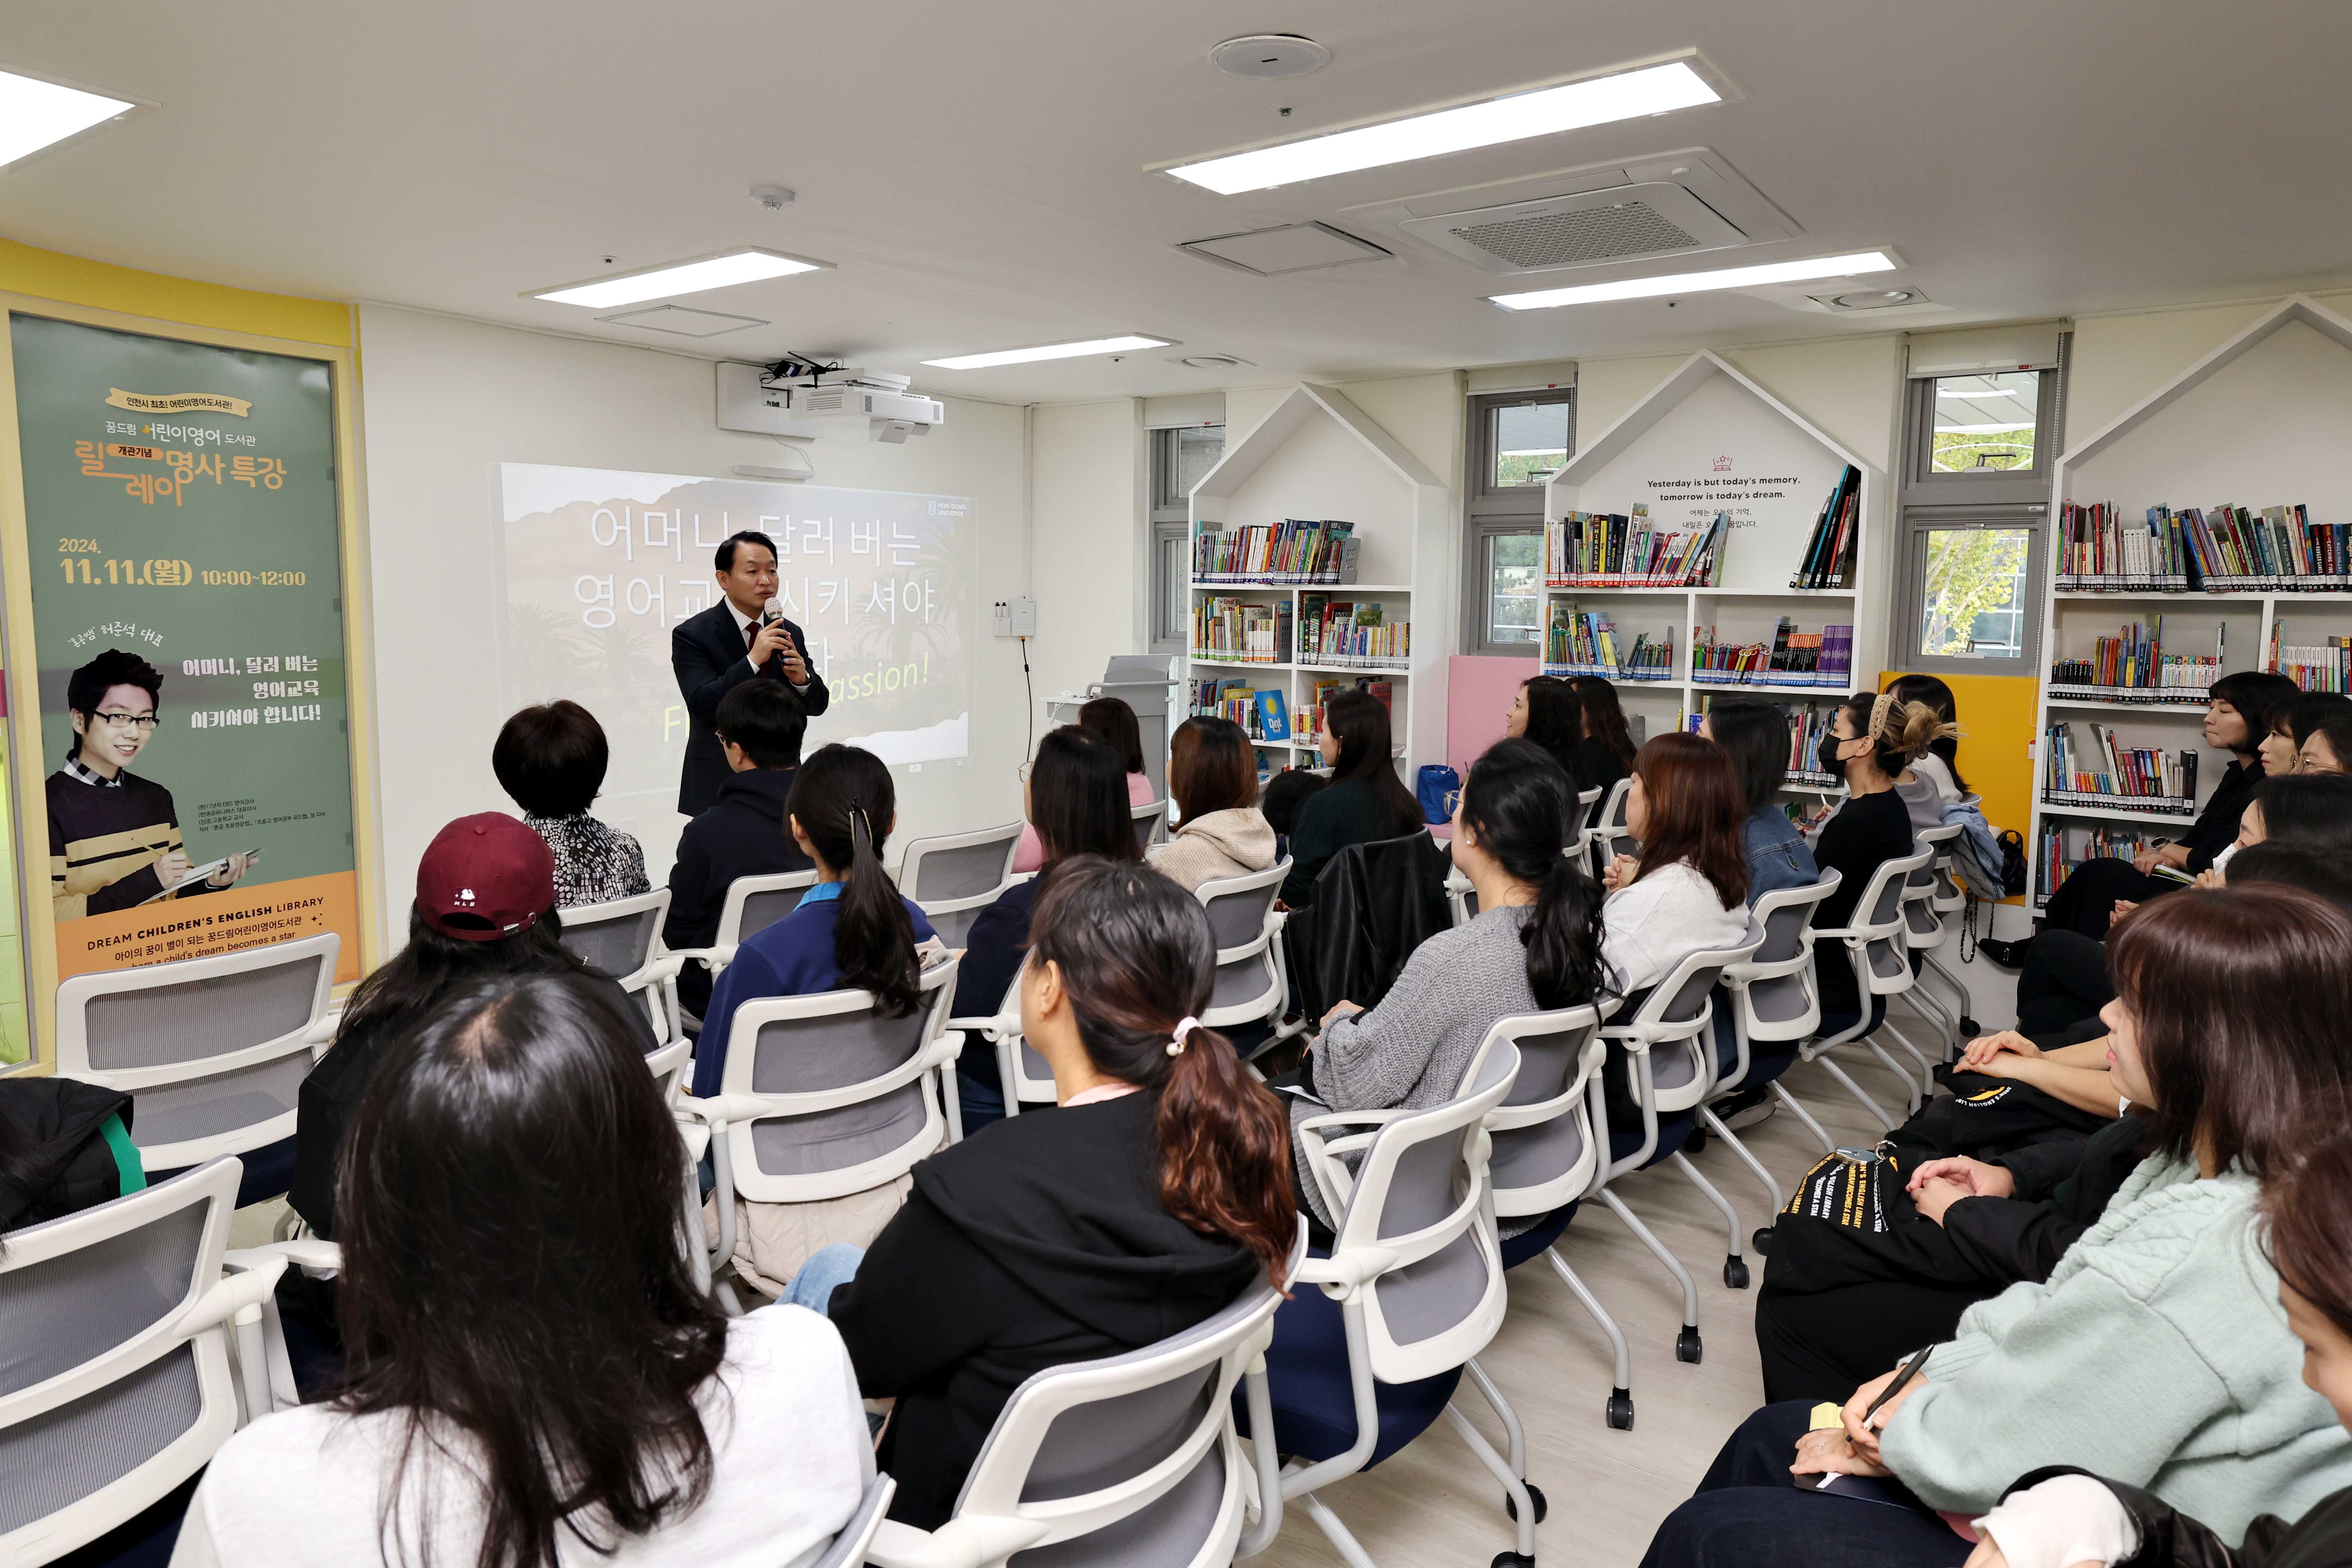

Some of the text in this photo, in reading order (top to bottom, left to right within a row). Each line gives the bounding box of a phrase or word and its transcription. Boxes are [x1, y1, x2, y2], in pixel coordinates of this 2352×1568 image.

[127, 397, 232, 410] 인천시 최초! 어린이영어도서관!
[105, 421, 257, 447] 꿈드림 어린이영어 도서관
[118, 446, 152, 458] 개관기념
[166, 450, 226, 485] 명사
[230, 456, 287, 490] 특강
[1648, 479, 1691, 488] Yesterday
[1723, 477, 1756, 486] today's
[1759, 477, 1800, 485] memory,
[1716, 491, 1750, 500] today's
[1736, 508, 1751, 516] 기억,
[591, 506, 921, 566] 어머니 달러 버는
[1682, 521, 1703, 529] 내일은
[1729, 520, 1759, 528] 꿈입니다.
[58, 538, 101, 554] 2024.
[60, 558, 306, 586] 11.11.(월) 10:00~12:00
[574, 574, 711, 628] 영어교
[100, 621, 135, 638] 허준석
[140, 628, 163, 647] 대표
[182, 655, 318, 676] 어머니, 달러 버는
[253, 680, 319, 699] 영어교육
[826, 651, 929, 705] assion!
[191, 704, 321, 729] 시키셔야 합니다!
[1268, 717, 1282, 729] Dot
[88, 897, 324, 950] DREAM CHILDREN'S ENGLISH LIBRARY
[115, 916, 302, 961] 아이의 꿈이 별이 되는 꿈드림어린이영어도서관
[164, 951, 192, 964] child's
[196, 946, 224, 957] dream
[227, 937, 269, 951] becomes
[279, 931, 296, 940] star
[1791, 1195, 1802, 1214] LIBRARY
[1844, 1183, 1854, 1208] BECOMES
[1857, 1180, 1867, 1206] ENGLISH
[1821, 1196, 1833, 1219] LIBRARY
[1841, 1212, 1850, 1225] STAR
[1853, 1205, 1864, 1229] LIBRARY
[1874, 1221, 1882, 1233] STAR
